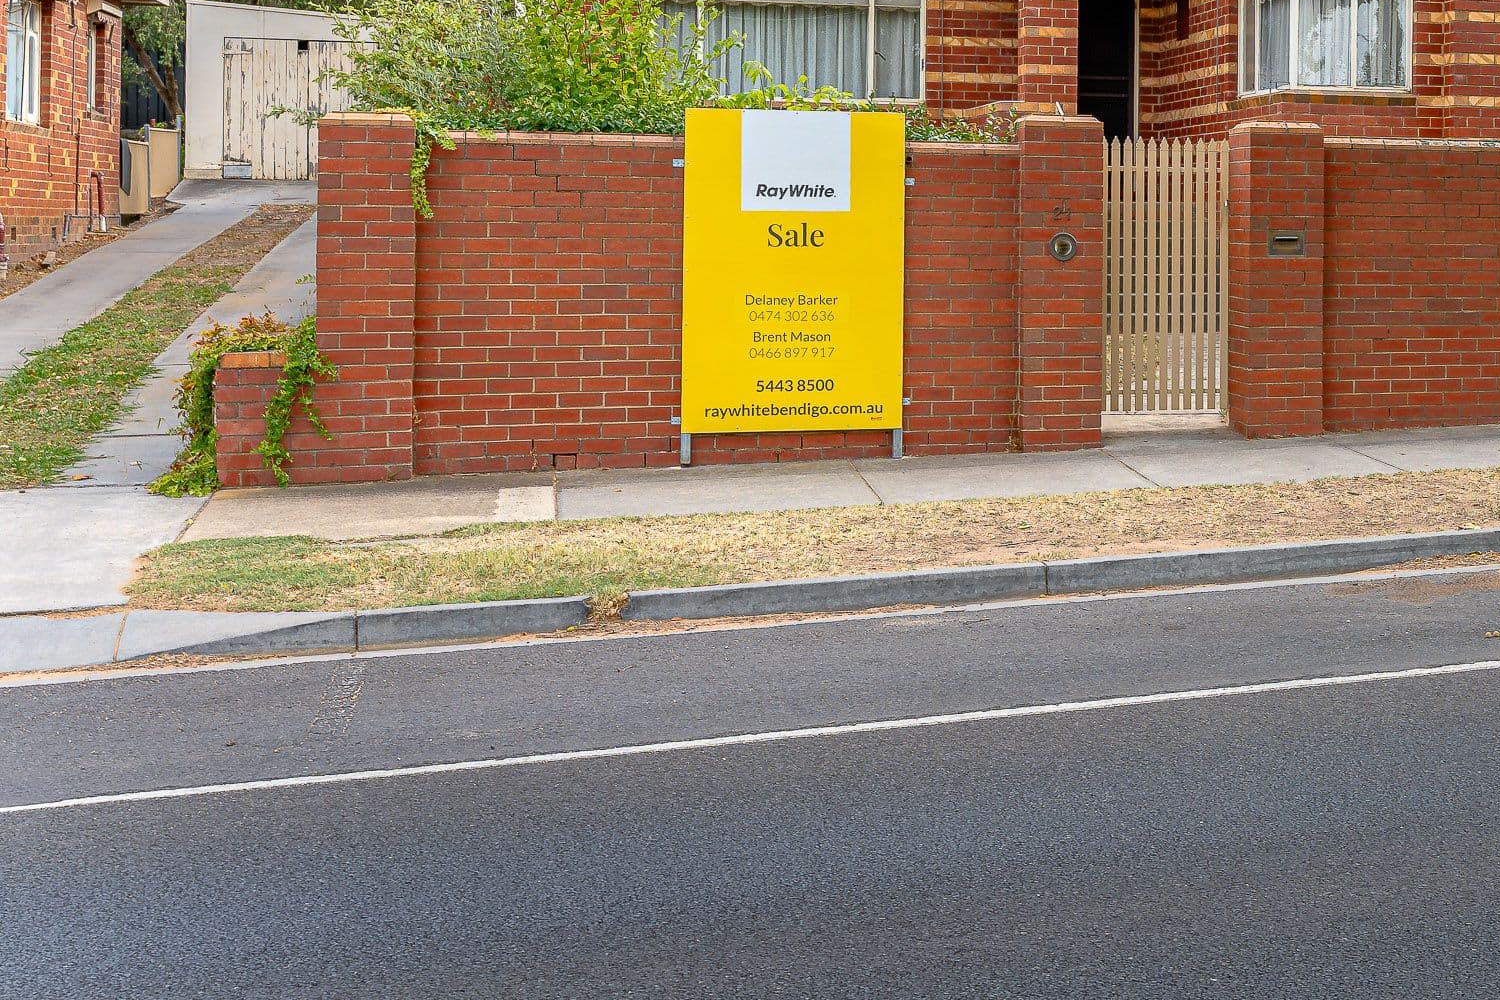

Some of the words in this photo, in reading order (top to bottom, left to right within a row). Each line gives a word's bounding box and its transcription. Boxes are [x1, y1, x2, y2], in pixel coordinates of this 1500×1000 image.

[767, 222, 825, 248] Sale
[745, 294, 795, 308] Delaney
[798, 294, 839, 306] Barker
[749, 310, 781, 322] 0474
[784, 310, 808, 322] 302
[811, 310, 835, 322] 636
[753, 331, 788, 343] Brent
[790, 331, 831, 342] Mason
[749, 347, 782, 359] 0466
[784, 347, 808, 358] 897
[811, 347, 835, 358] 917
[756, 379, 794, 393] 5443
[797, 378, 835, 392] 8500
[704, 402, 883, 420] raywhitebendigo.com.au
